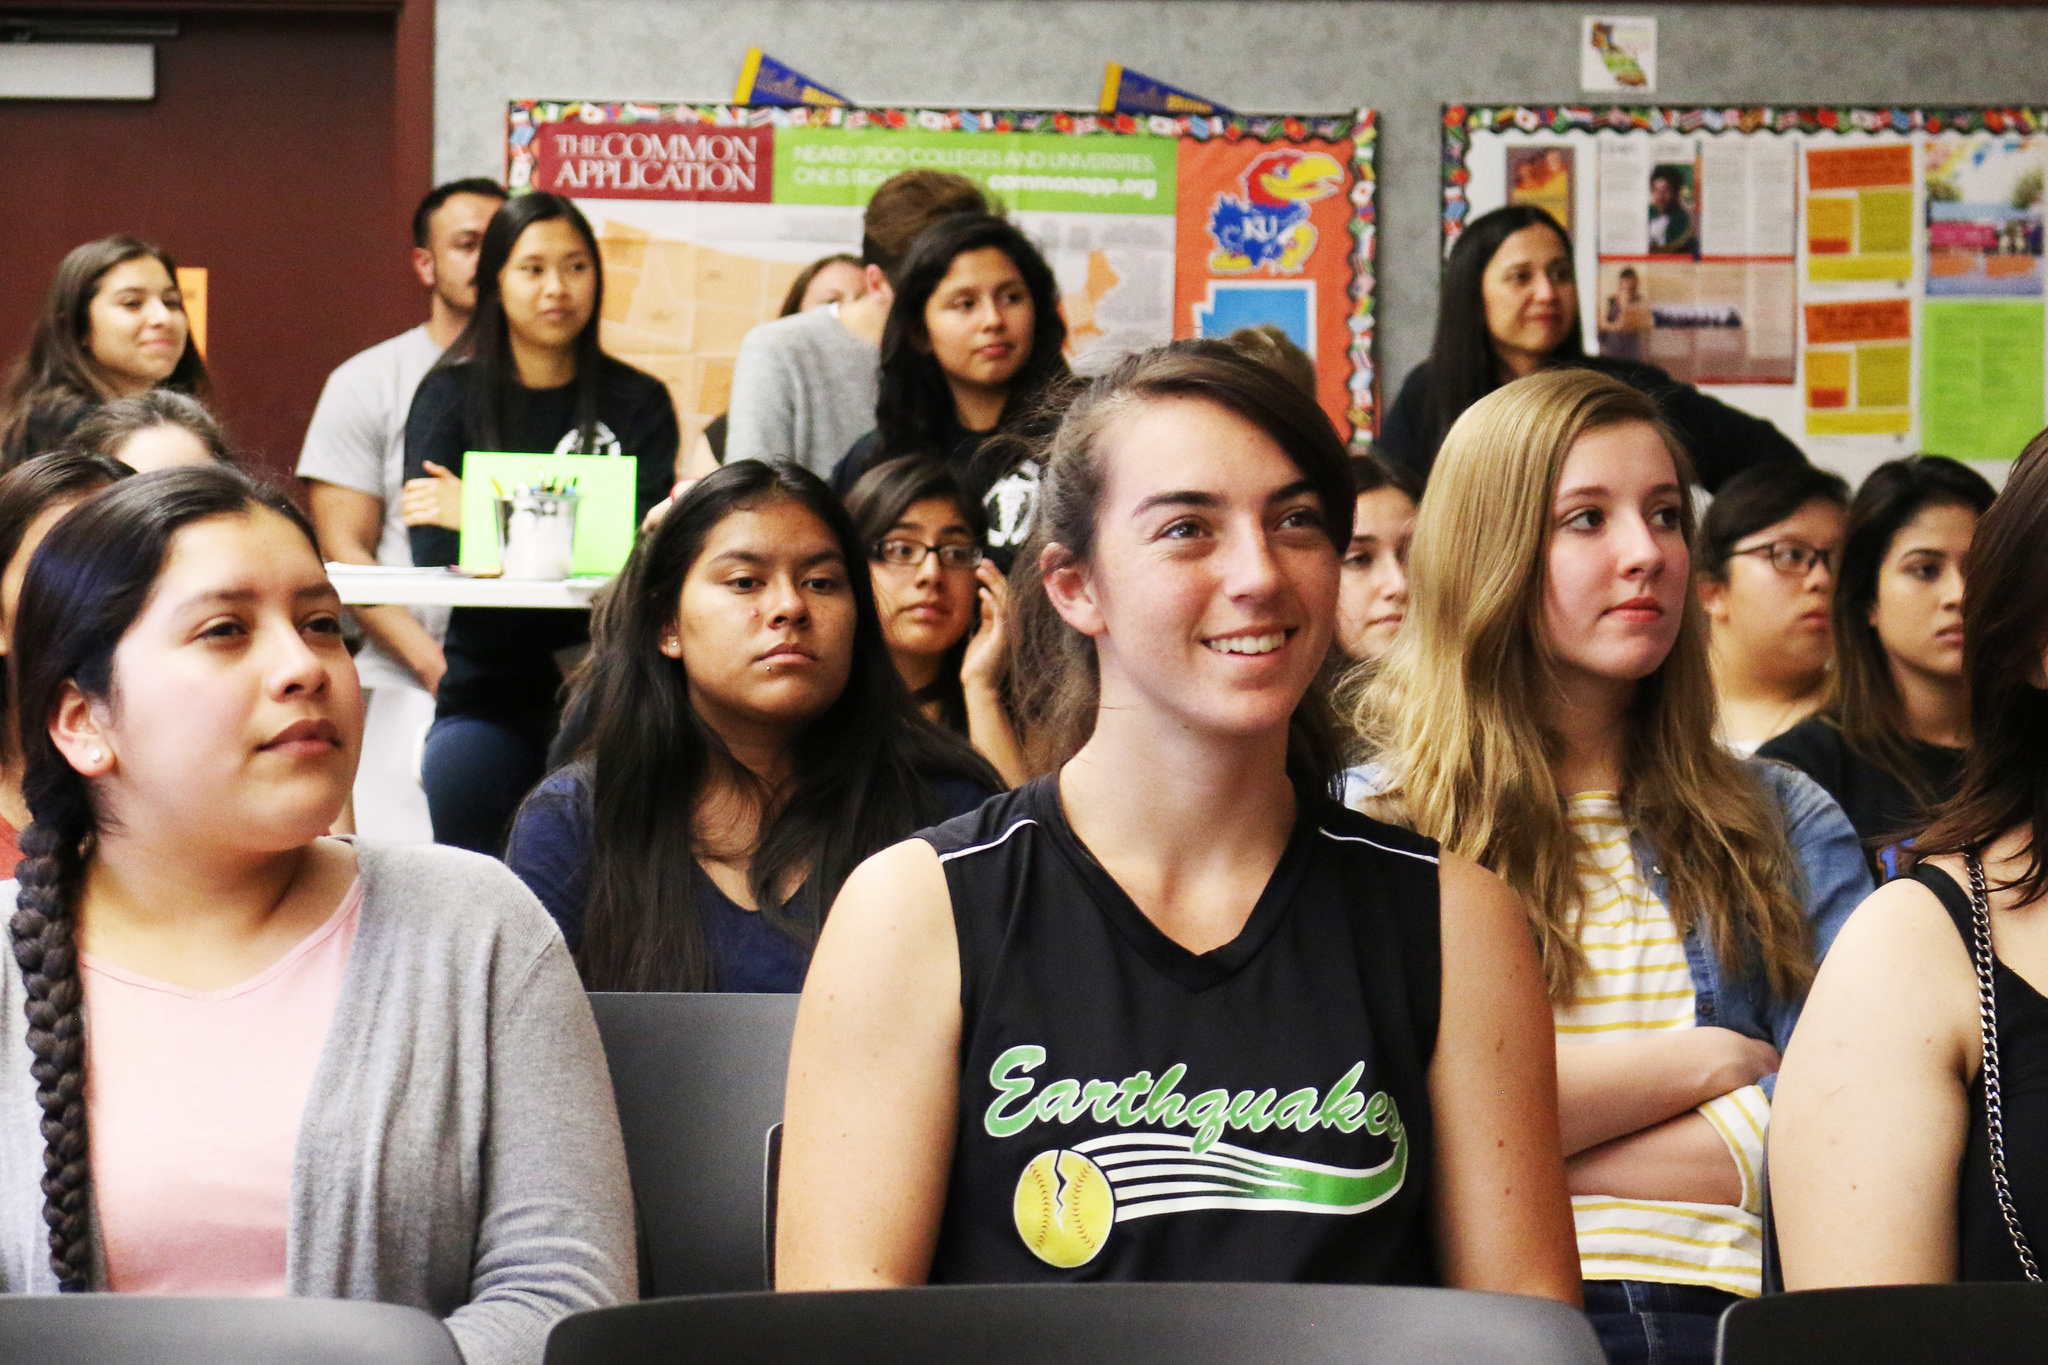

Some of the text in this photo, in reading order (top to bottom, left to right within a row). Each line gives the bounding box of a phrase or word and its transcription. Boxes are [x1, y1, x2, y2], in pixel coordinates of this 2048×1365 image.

[554, 132, 757, 163] THE COMMON
[862, 147, 906, 166] 700
[908, 148, 1002, 168] COLLEGES
[1004, 150, 1047, 169] AND
[554, 160, 756, 192] APPLICATION
[988, 174, 1157, 199] commonapp.org
[1243, 215, 1278, 242] KU
[984, 1044, 1405, 1154] Earthquakes
